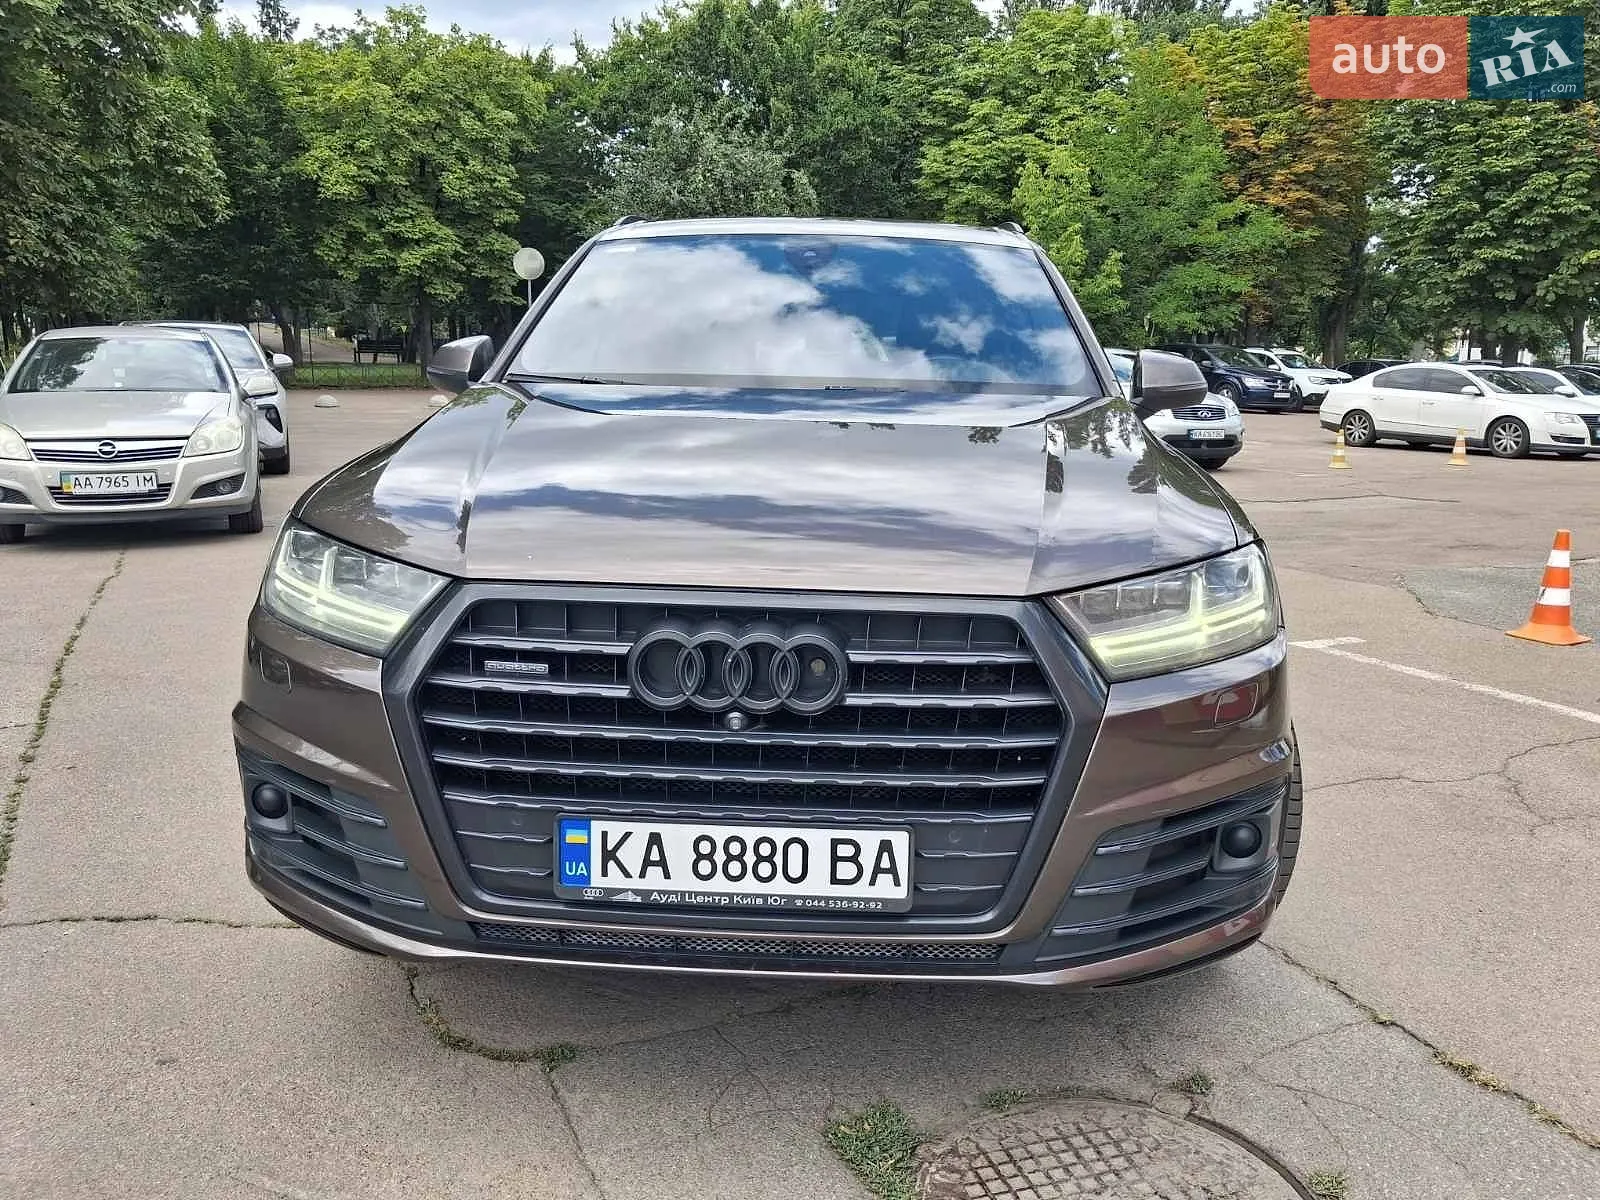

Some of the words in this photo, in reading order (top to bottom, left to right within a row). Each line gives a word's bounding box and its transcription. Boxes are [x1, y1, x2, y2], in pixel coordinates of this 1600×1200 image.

[73, 477, 93, 489] AA
[96, 475, 129, 489] 7965
[136, 472, 154, 488] IM
[600, 830, 672, 880] KA
[692, 834, 809, 883] 8880
[829, 838, 902, 887] BA
[565, 861, 588, 876] UA
[650, 891, 681, 904] Ауді
[685, 893, 730, 906] Центр
[733, 895, 763, 906] Київ
[767, 896, 787, 906] Юг
[805, 899, 826, 907] 044
